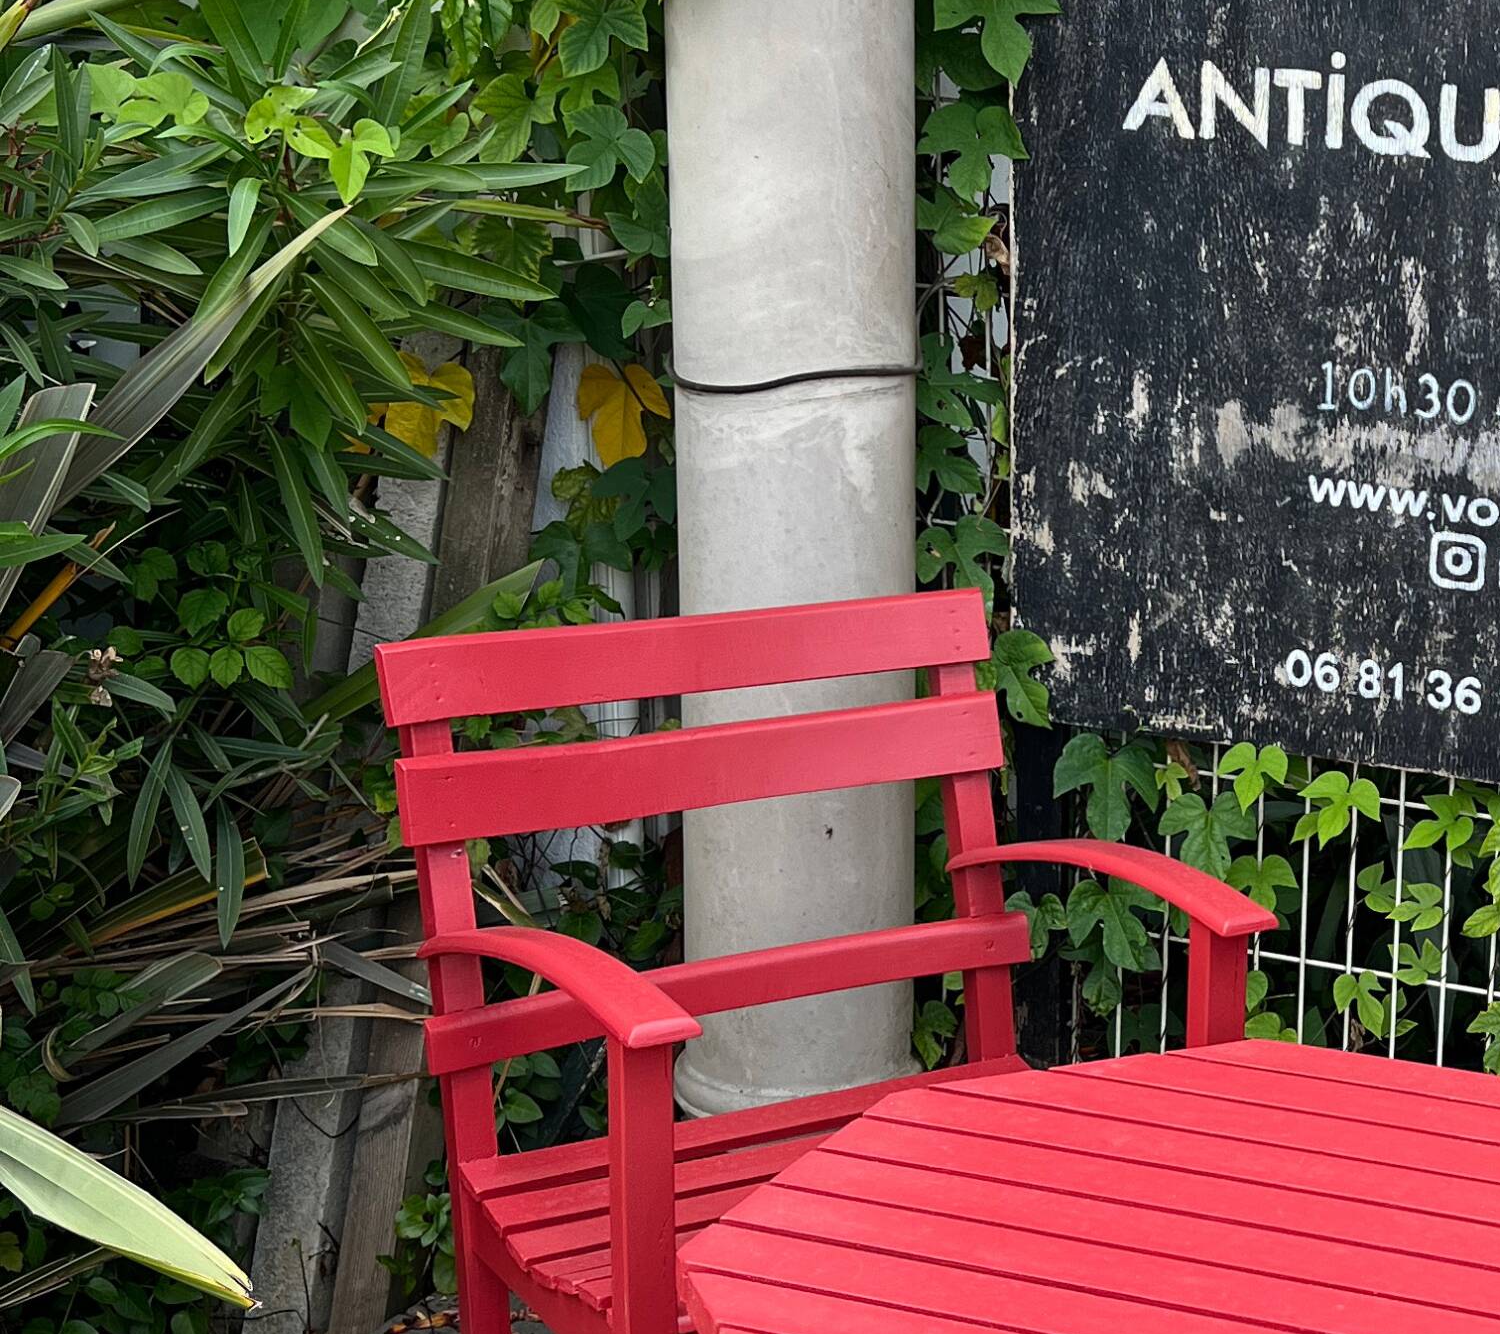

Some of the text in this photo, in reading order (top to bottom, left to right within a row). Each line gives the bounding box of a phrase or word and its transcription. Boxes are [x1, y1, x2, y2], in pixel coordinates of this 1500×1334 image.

[1316, 360, 1478, 426] 10h30
[1284, 649, 1341, 693] 06
[1357, 659, 1403, 701] 81
[1427, 669, 1483, 715] 36
